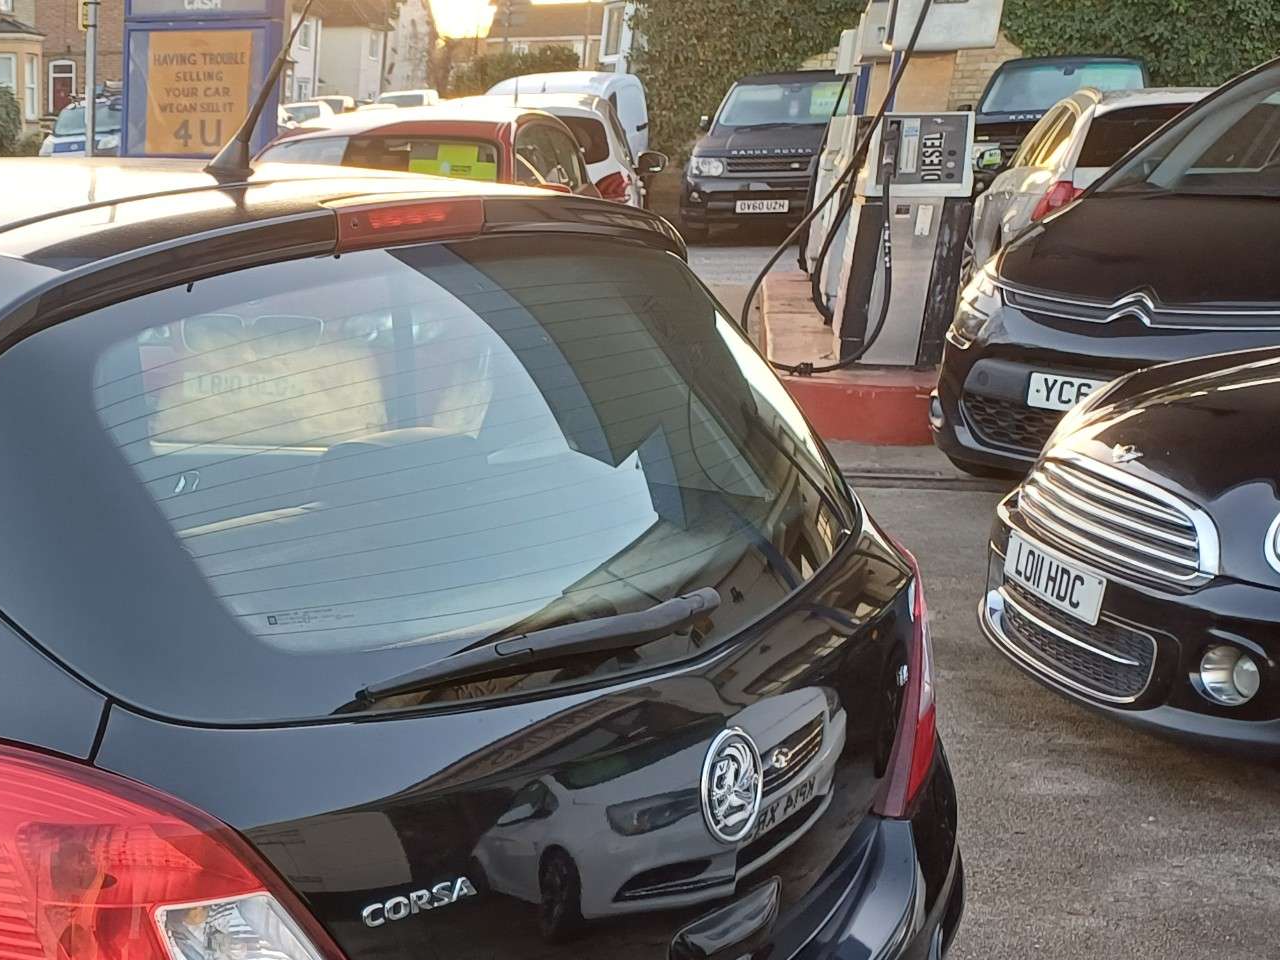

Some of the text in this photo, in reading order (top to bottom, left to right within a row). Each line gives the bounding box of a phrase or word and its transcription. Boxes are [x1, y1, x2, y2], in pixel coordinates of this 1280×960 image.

[153, 51, 246, 66] HAVING TROUBLE
[175, 71, 223, 82] SELLING
[164, 87, 231, 98] YOUR CAR
[176, 103, 197, 113] CAN
[174, 119, 222, 147] 4 U
[920, 131, 945, 181] DIESEL
[1043, 377, 1092, 405] YC6
[1014, 542, 1085, 609] LO11 HDC
[362, 876, 477, 928] CORSA
